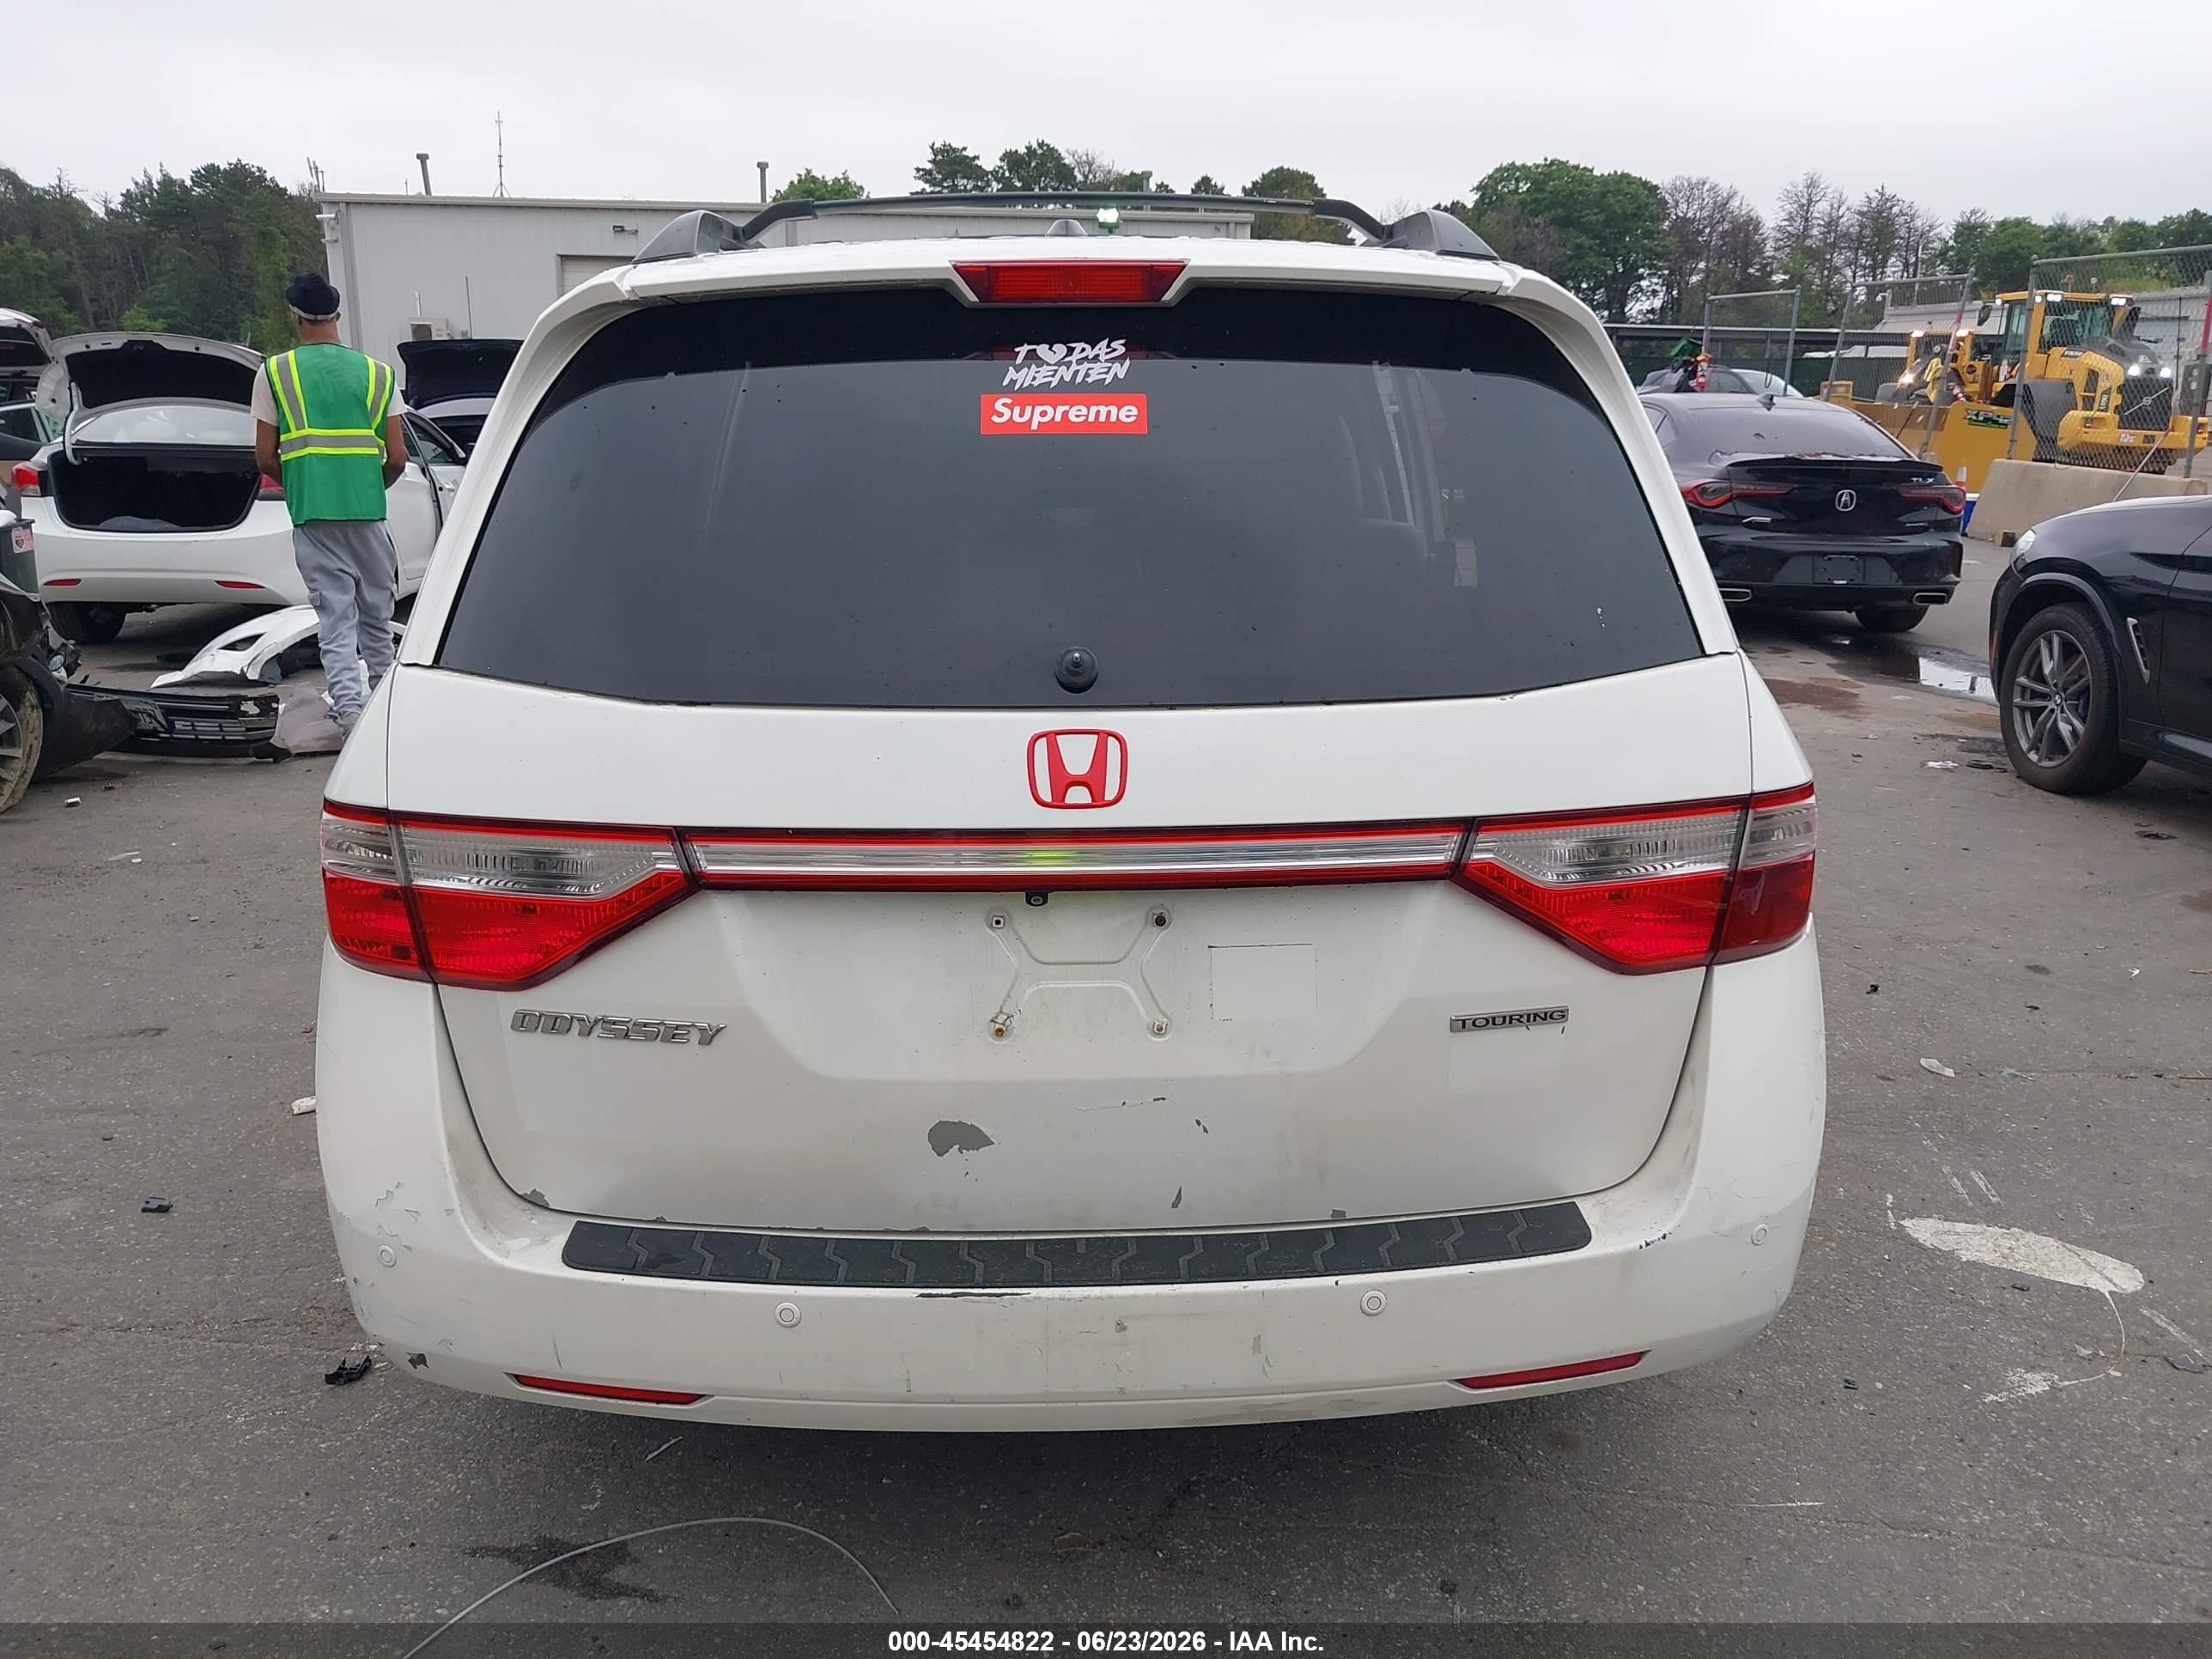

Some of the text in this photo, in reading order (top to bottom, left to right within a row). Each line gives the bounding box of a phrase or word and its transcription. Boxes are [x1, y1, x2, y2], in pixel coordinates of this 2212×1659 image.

[1002, 357, 1131, 391] MIENTEN
[990, 397, 1139, 430] Supreme
[510, 1008, 728, 1046] ODYSSEY
[1455, 1010, 1567, 1030] TOURING
